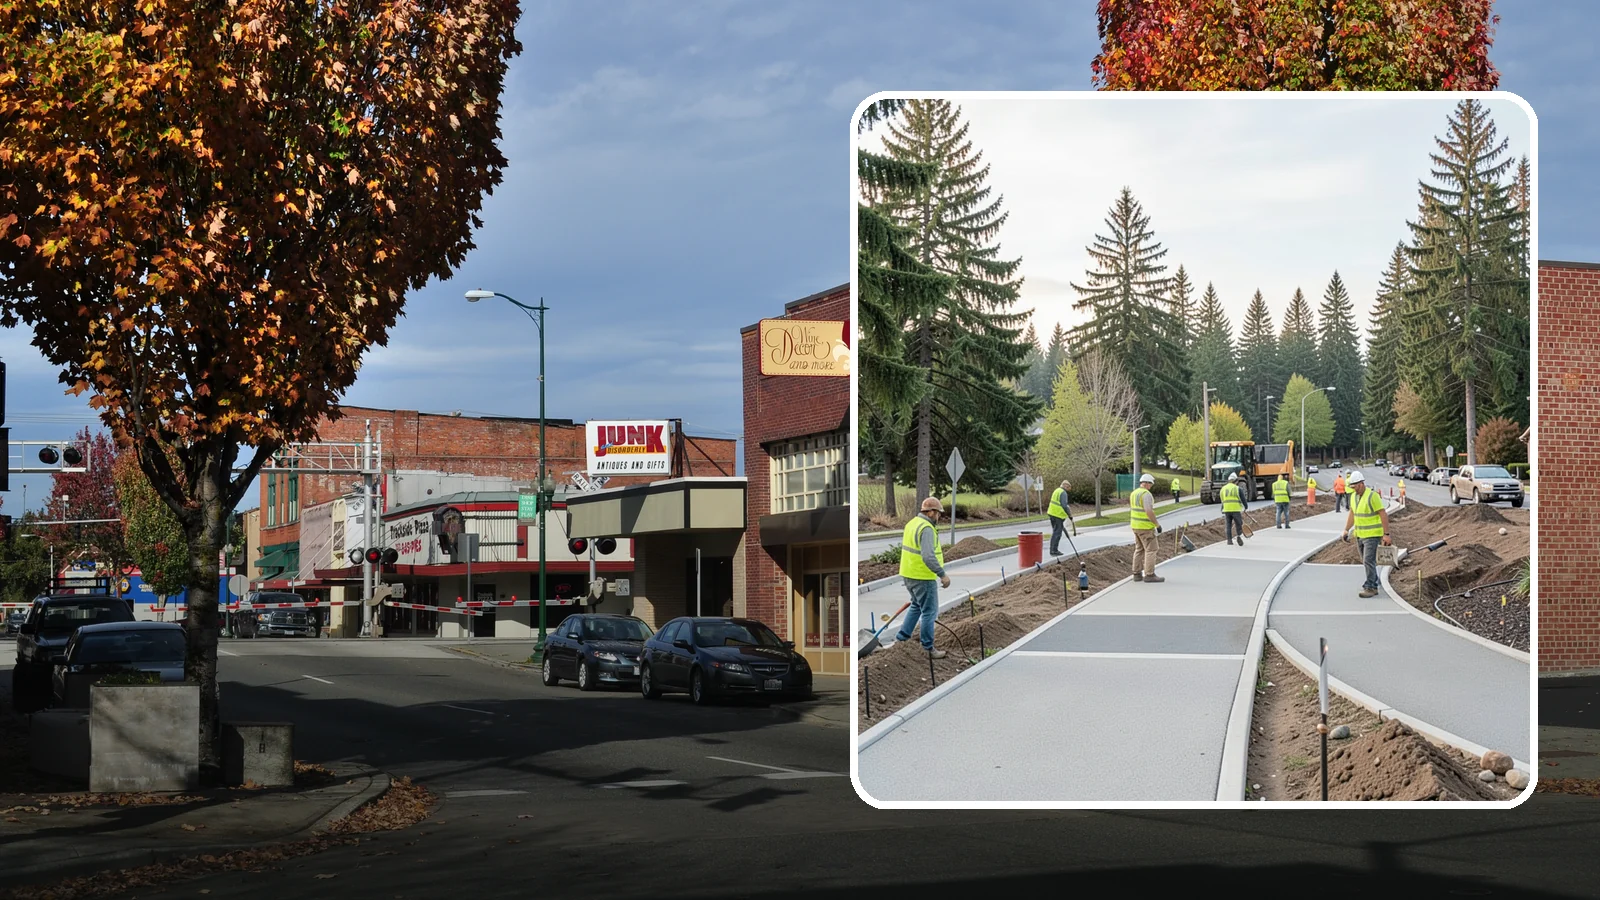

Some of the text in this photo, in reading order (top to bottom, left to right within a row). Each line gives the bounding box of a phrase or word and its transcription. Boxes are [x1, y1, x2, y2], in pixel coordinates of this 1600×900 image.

[596, 426, 665, 457] JUNK
[607, 446, 646, 454] DISORDERLY
[597, 461, 665, 470] ANTIQUES AND GIFTS
[390, 519, 429, 539] Trackside Pizza
